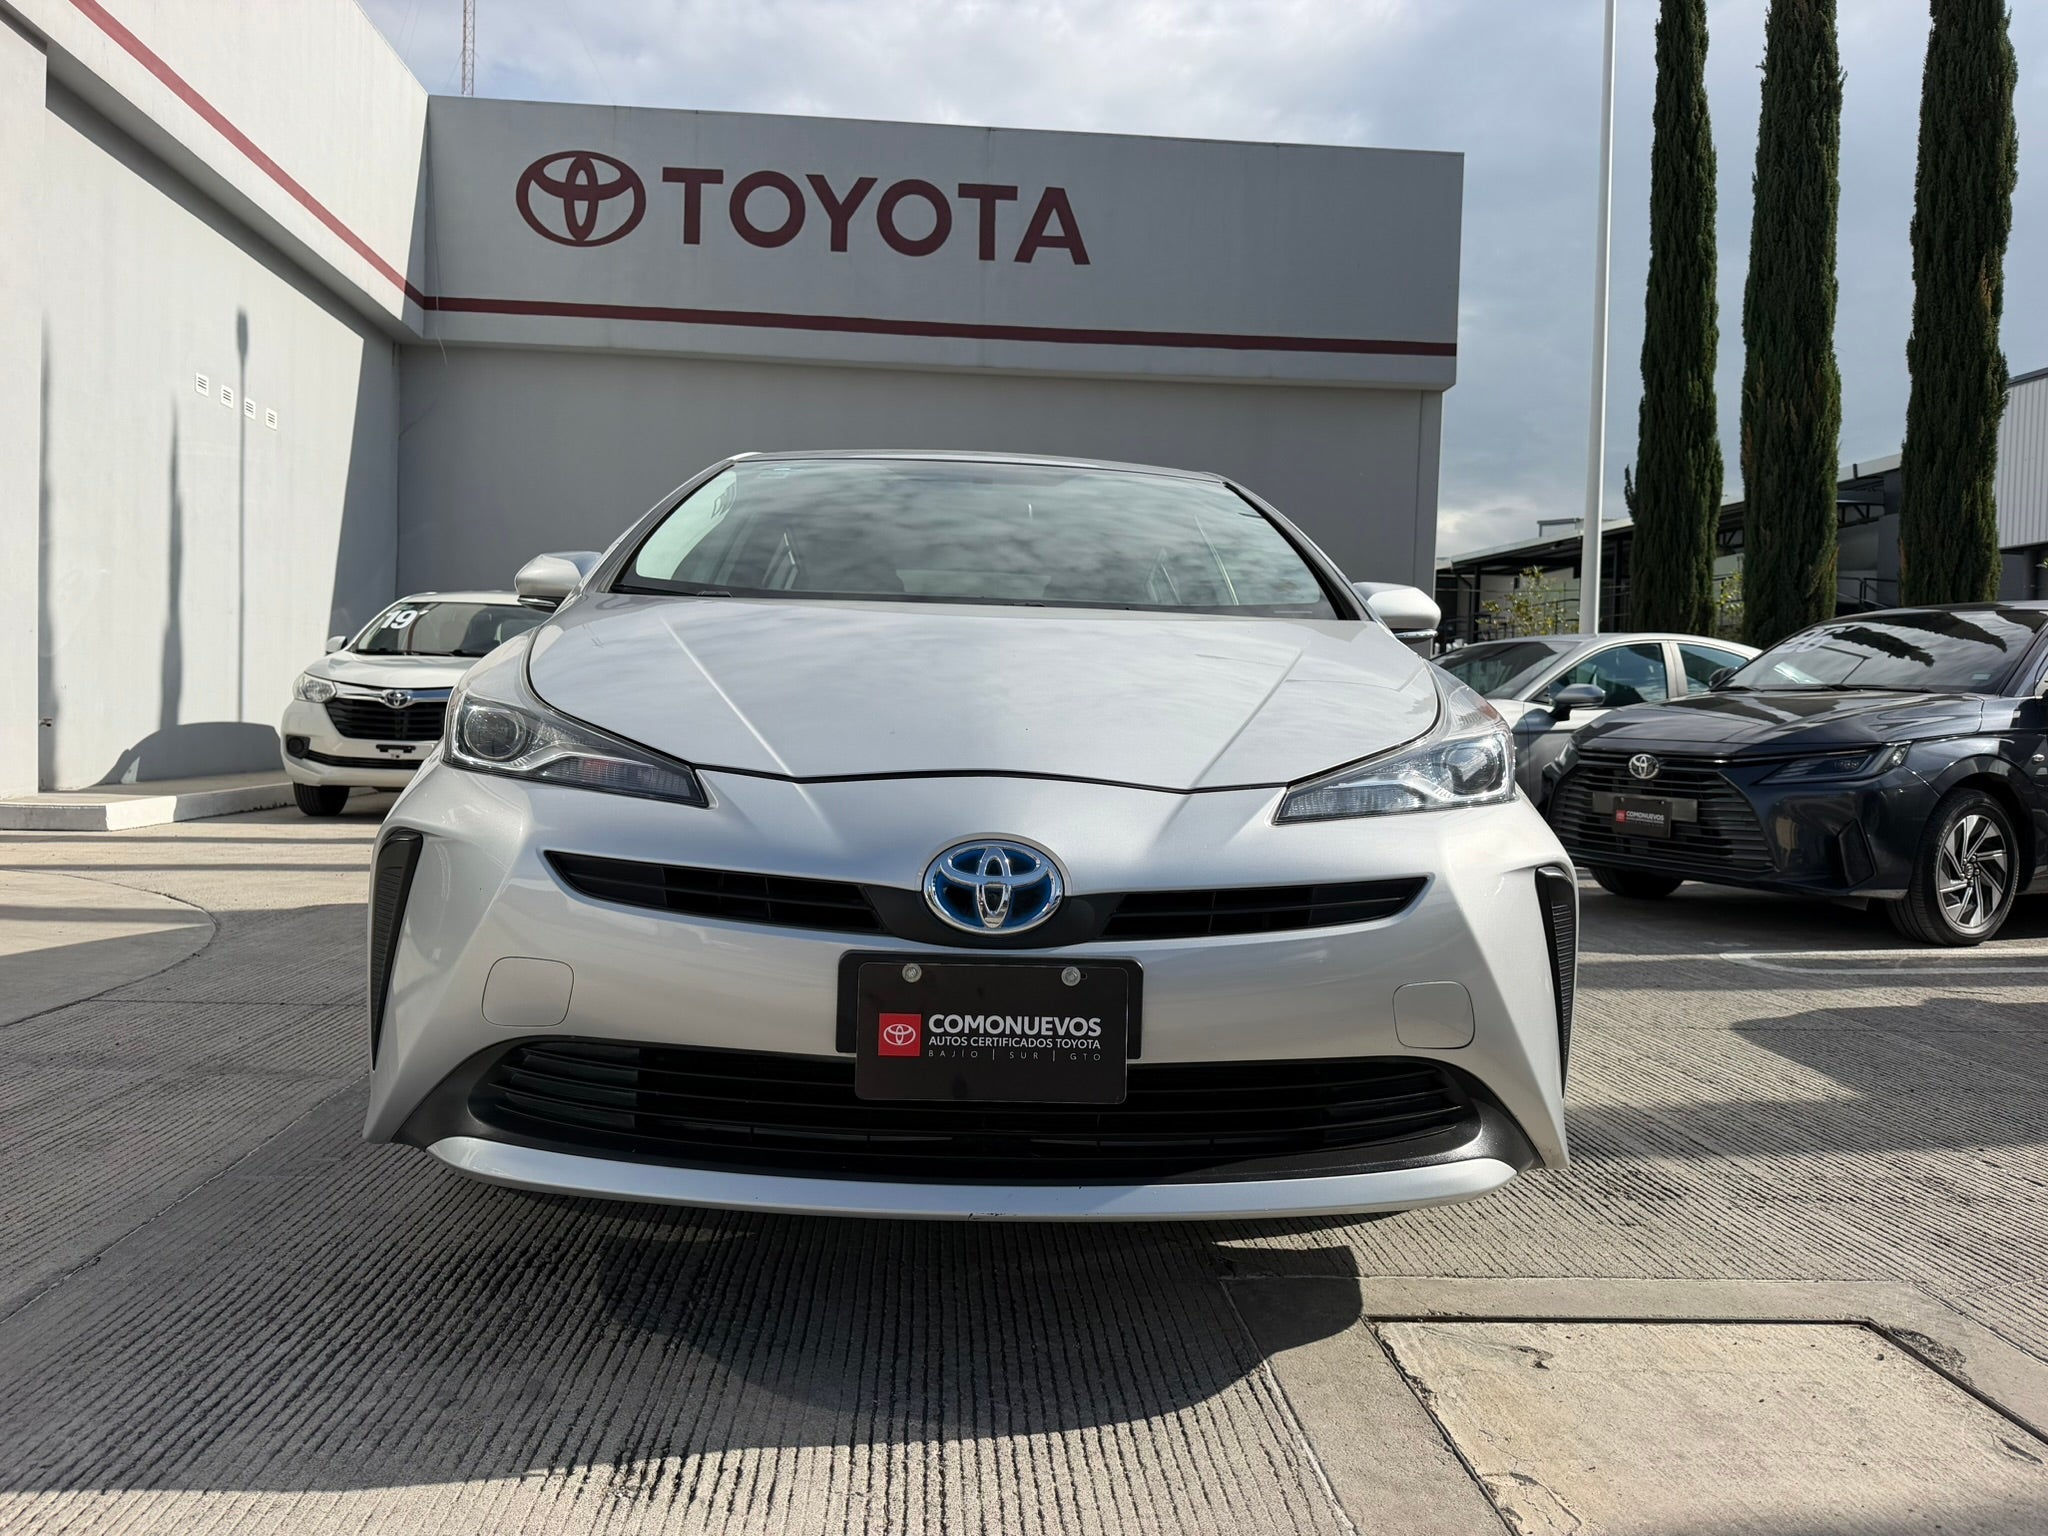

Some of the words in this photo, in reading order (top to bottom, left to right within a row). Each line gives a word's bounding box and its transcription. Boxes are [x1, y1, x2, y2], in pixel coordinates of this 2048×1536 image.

[662, 167, 1090, 265] TOYOTA
[929, 1014, 1101, 1036] COMONUEVOS
[929, 1036, 968, 1046] AUTOS
[970, 1036, 1053, 1048] CERTIFICADOS
[1056, 1039, 1100, 1049] TOYOTA
[1009, 1051, 1039, 1060] SUR
[1069, 1053, 1101, 1061] GTO
